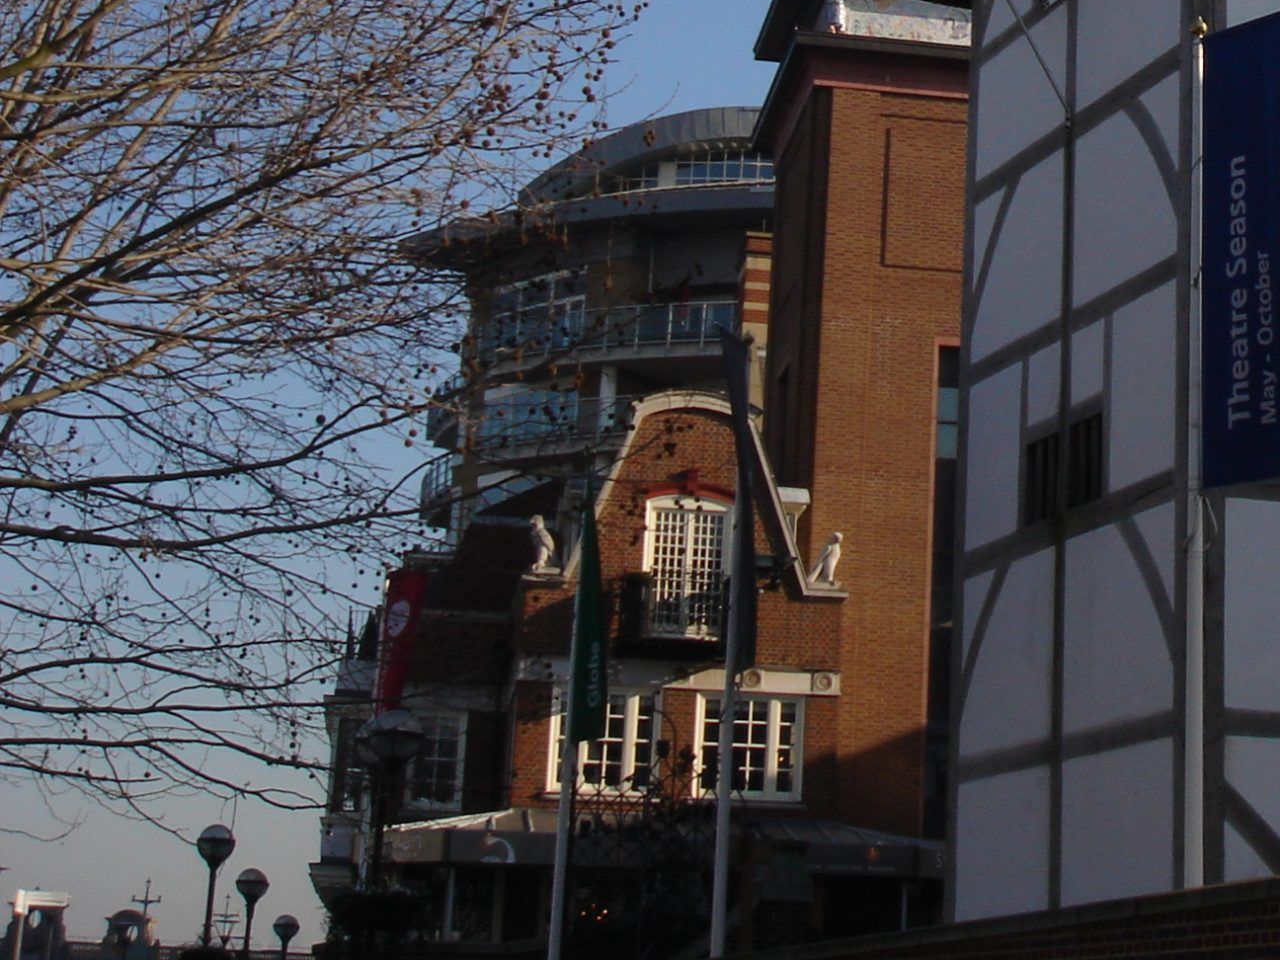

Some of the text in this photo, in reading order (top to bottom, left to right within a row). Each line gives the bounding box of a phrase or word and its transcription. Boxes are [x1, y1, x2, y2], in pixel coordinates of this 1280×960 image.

[1226, 155, 1251, 429] Theatre Season
[1255, 250, 1273, 346] October
[1260, 369, 1277, 424] May
